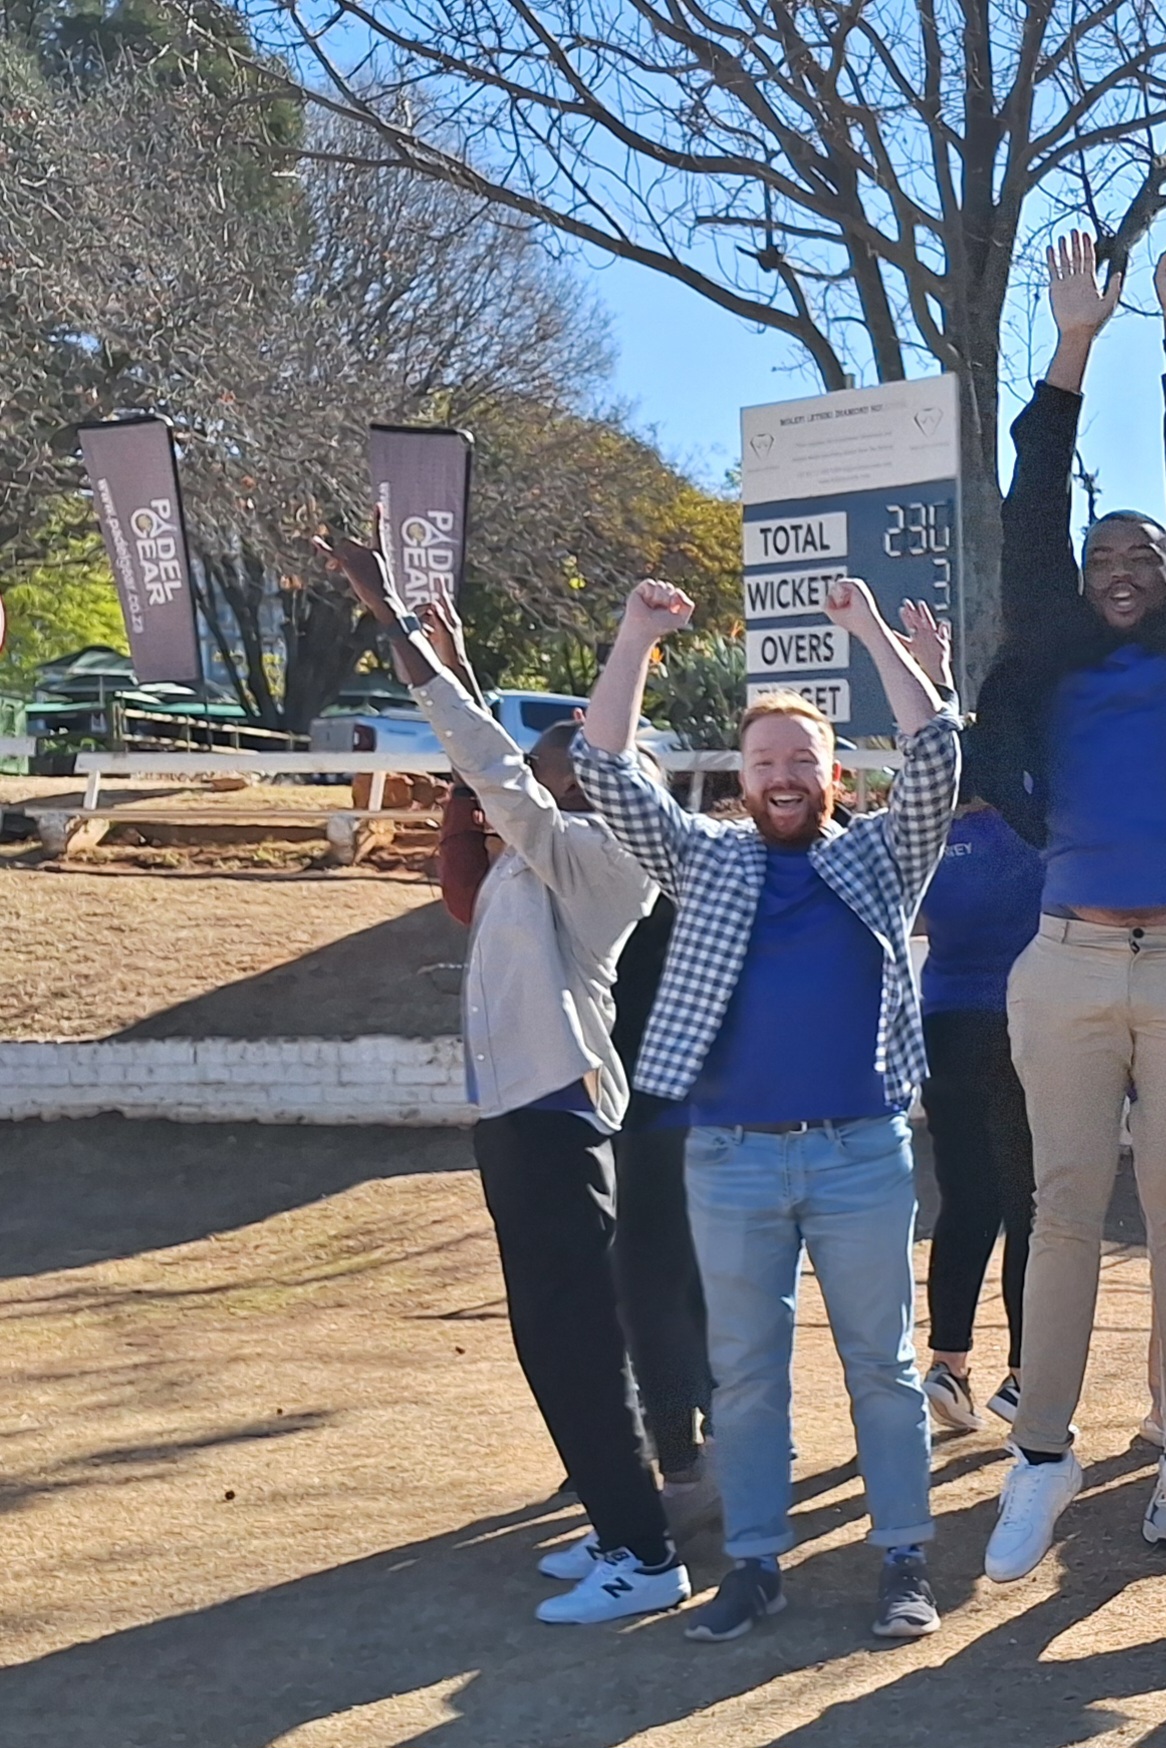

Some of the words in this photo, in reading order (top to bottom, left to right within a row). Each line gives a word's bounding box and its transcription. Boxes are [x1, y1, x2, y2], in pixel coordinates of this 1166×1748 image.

[150, 498, 182, 602] PADEL
[759, 521, 831, 557] TOTAL
[747, 573, 846, 612] WICKET
[761, 631, 834, 666] OVERS
